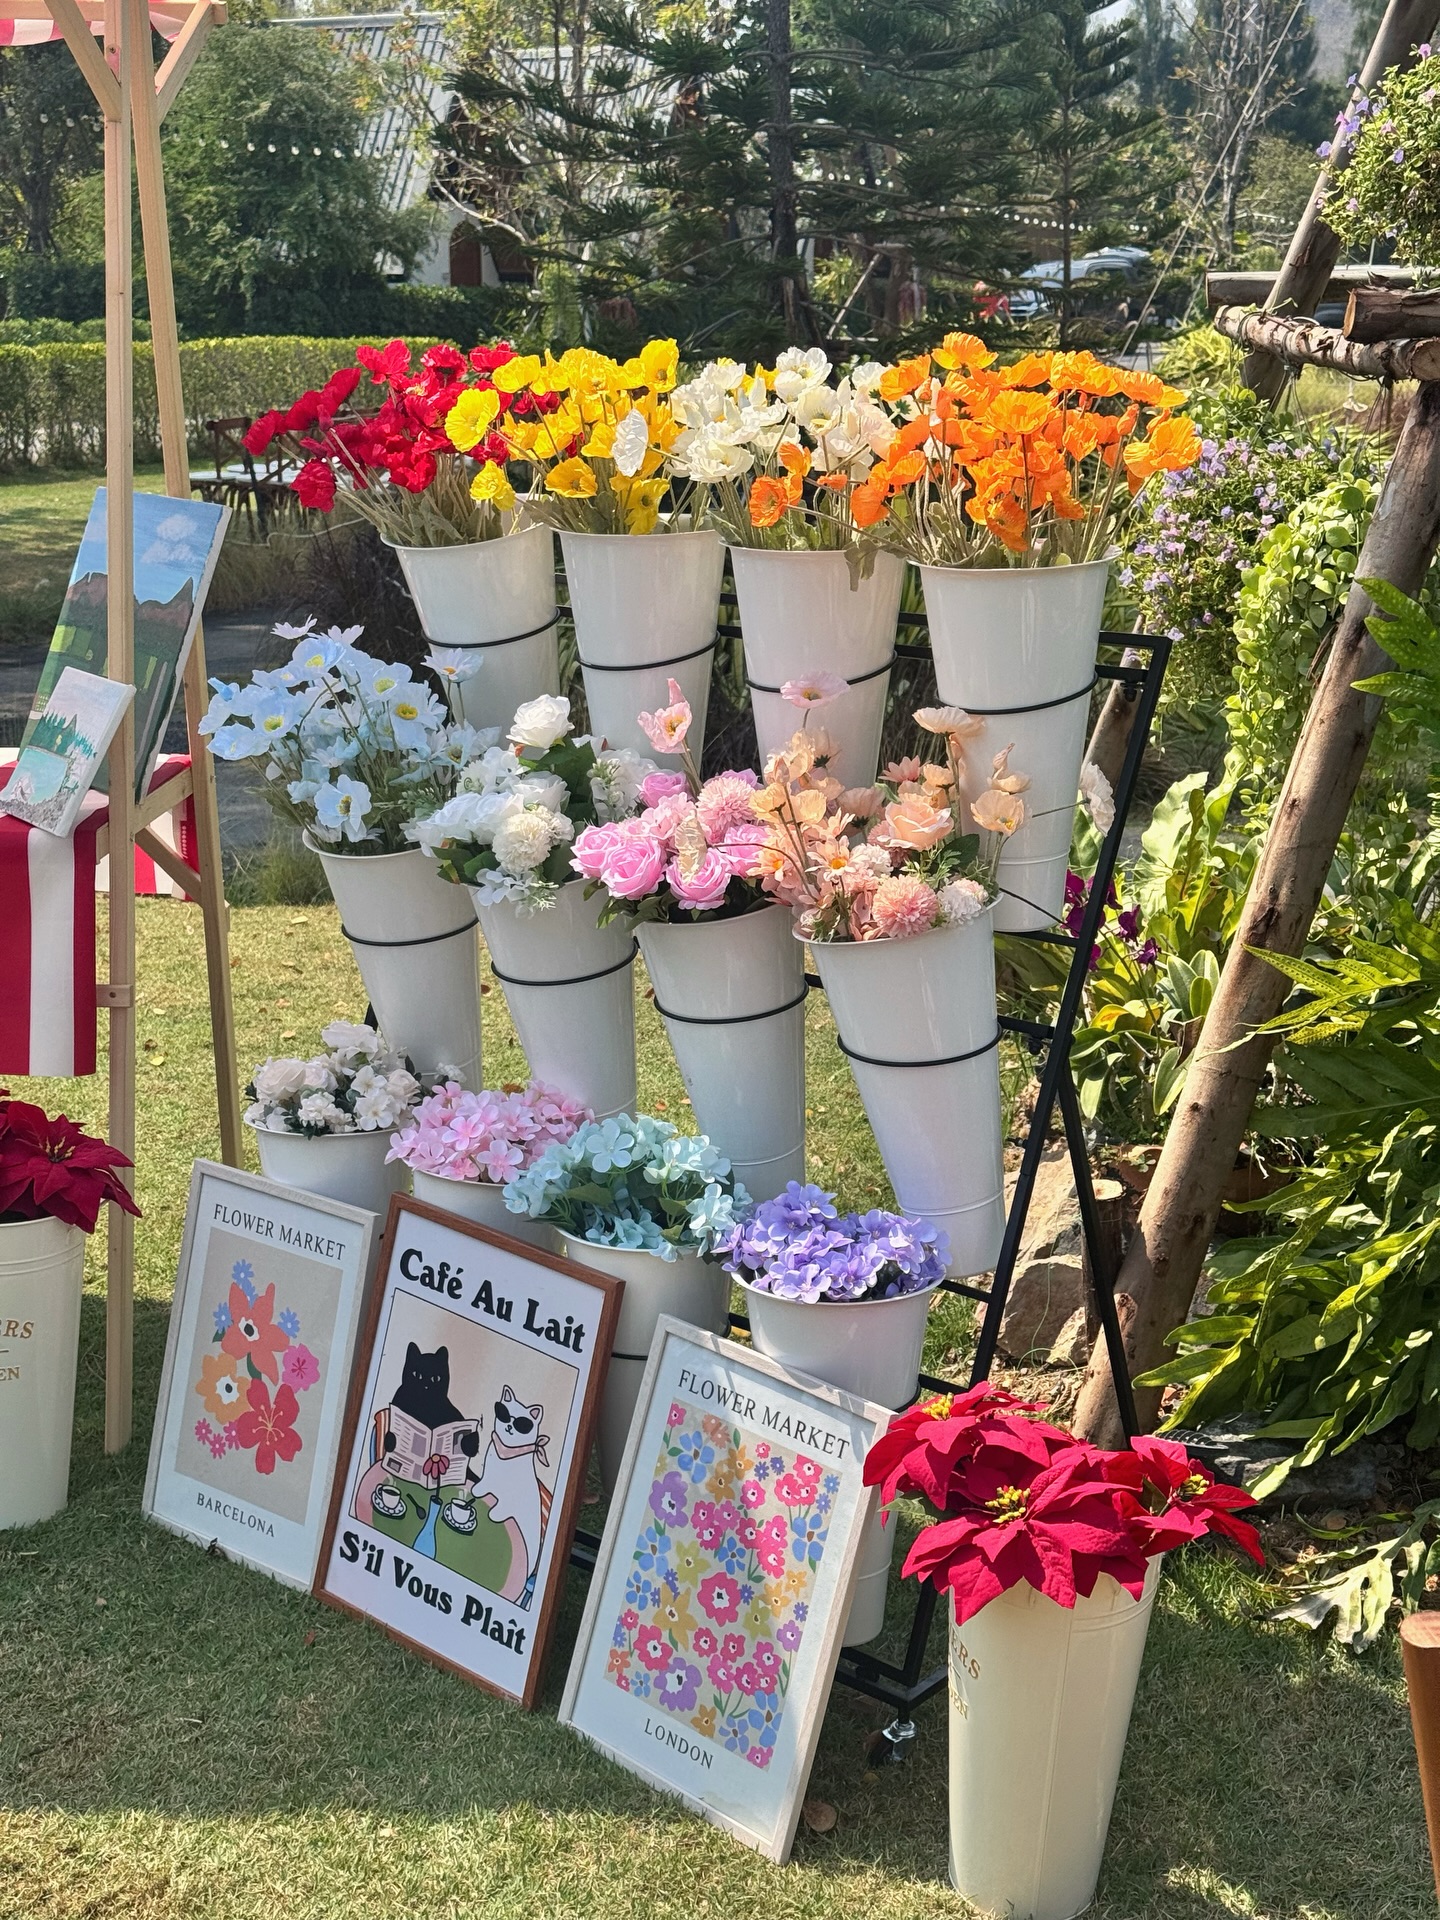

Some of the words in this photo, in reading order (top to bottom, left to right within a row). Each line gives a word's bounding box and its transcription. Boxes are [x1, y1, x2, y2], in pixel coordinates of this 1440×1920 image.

[213, 1203, 274, 1238] FLOWER
[279, 1224, 346, 1261] MARKET
[400, 1248, 464, 1299] Café
[471, 1279, 513, 1322] Au
[523, 1298, 585, 1353] Lait
[678, 1369, 756, 1421] FLOWER
[761, 1405, 850, 1460] MARKET
[196, 1492, 275, 1537] BARCELONA
[339, 1530, 385, 1577] S'il
[393, 1556, 452, 1615] Vous
[460, 1594, 526, 1655] Plaît
[644, 1718, 714, 1770] LONDON
